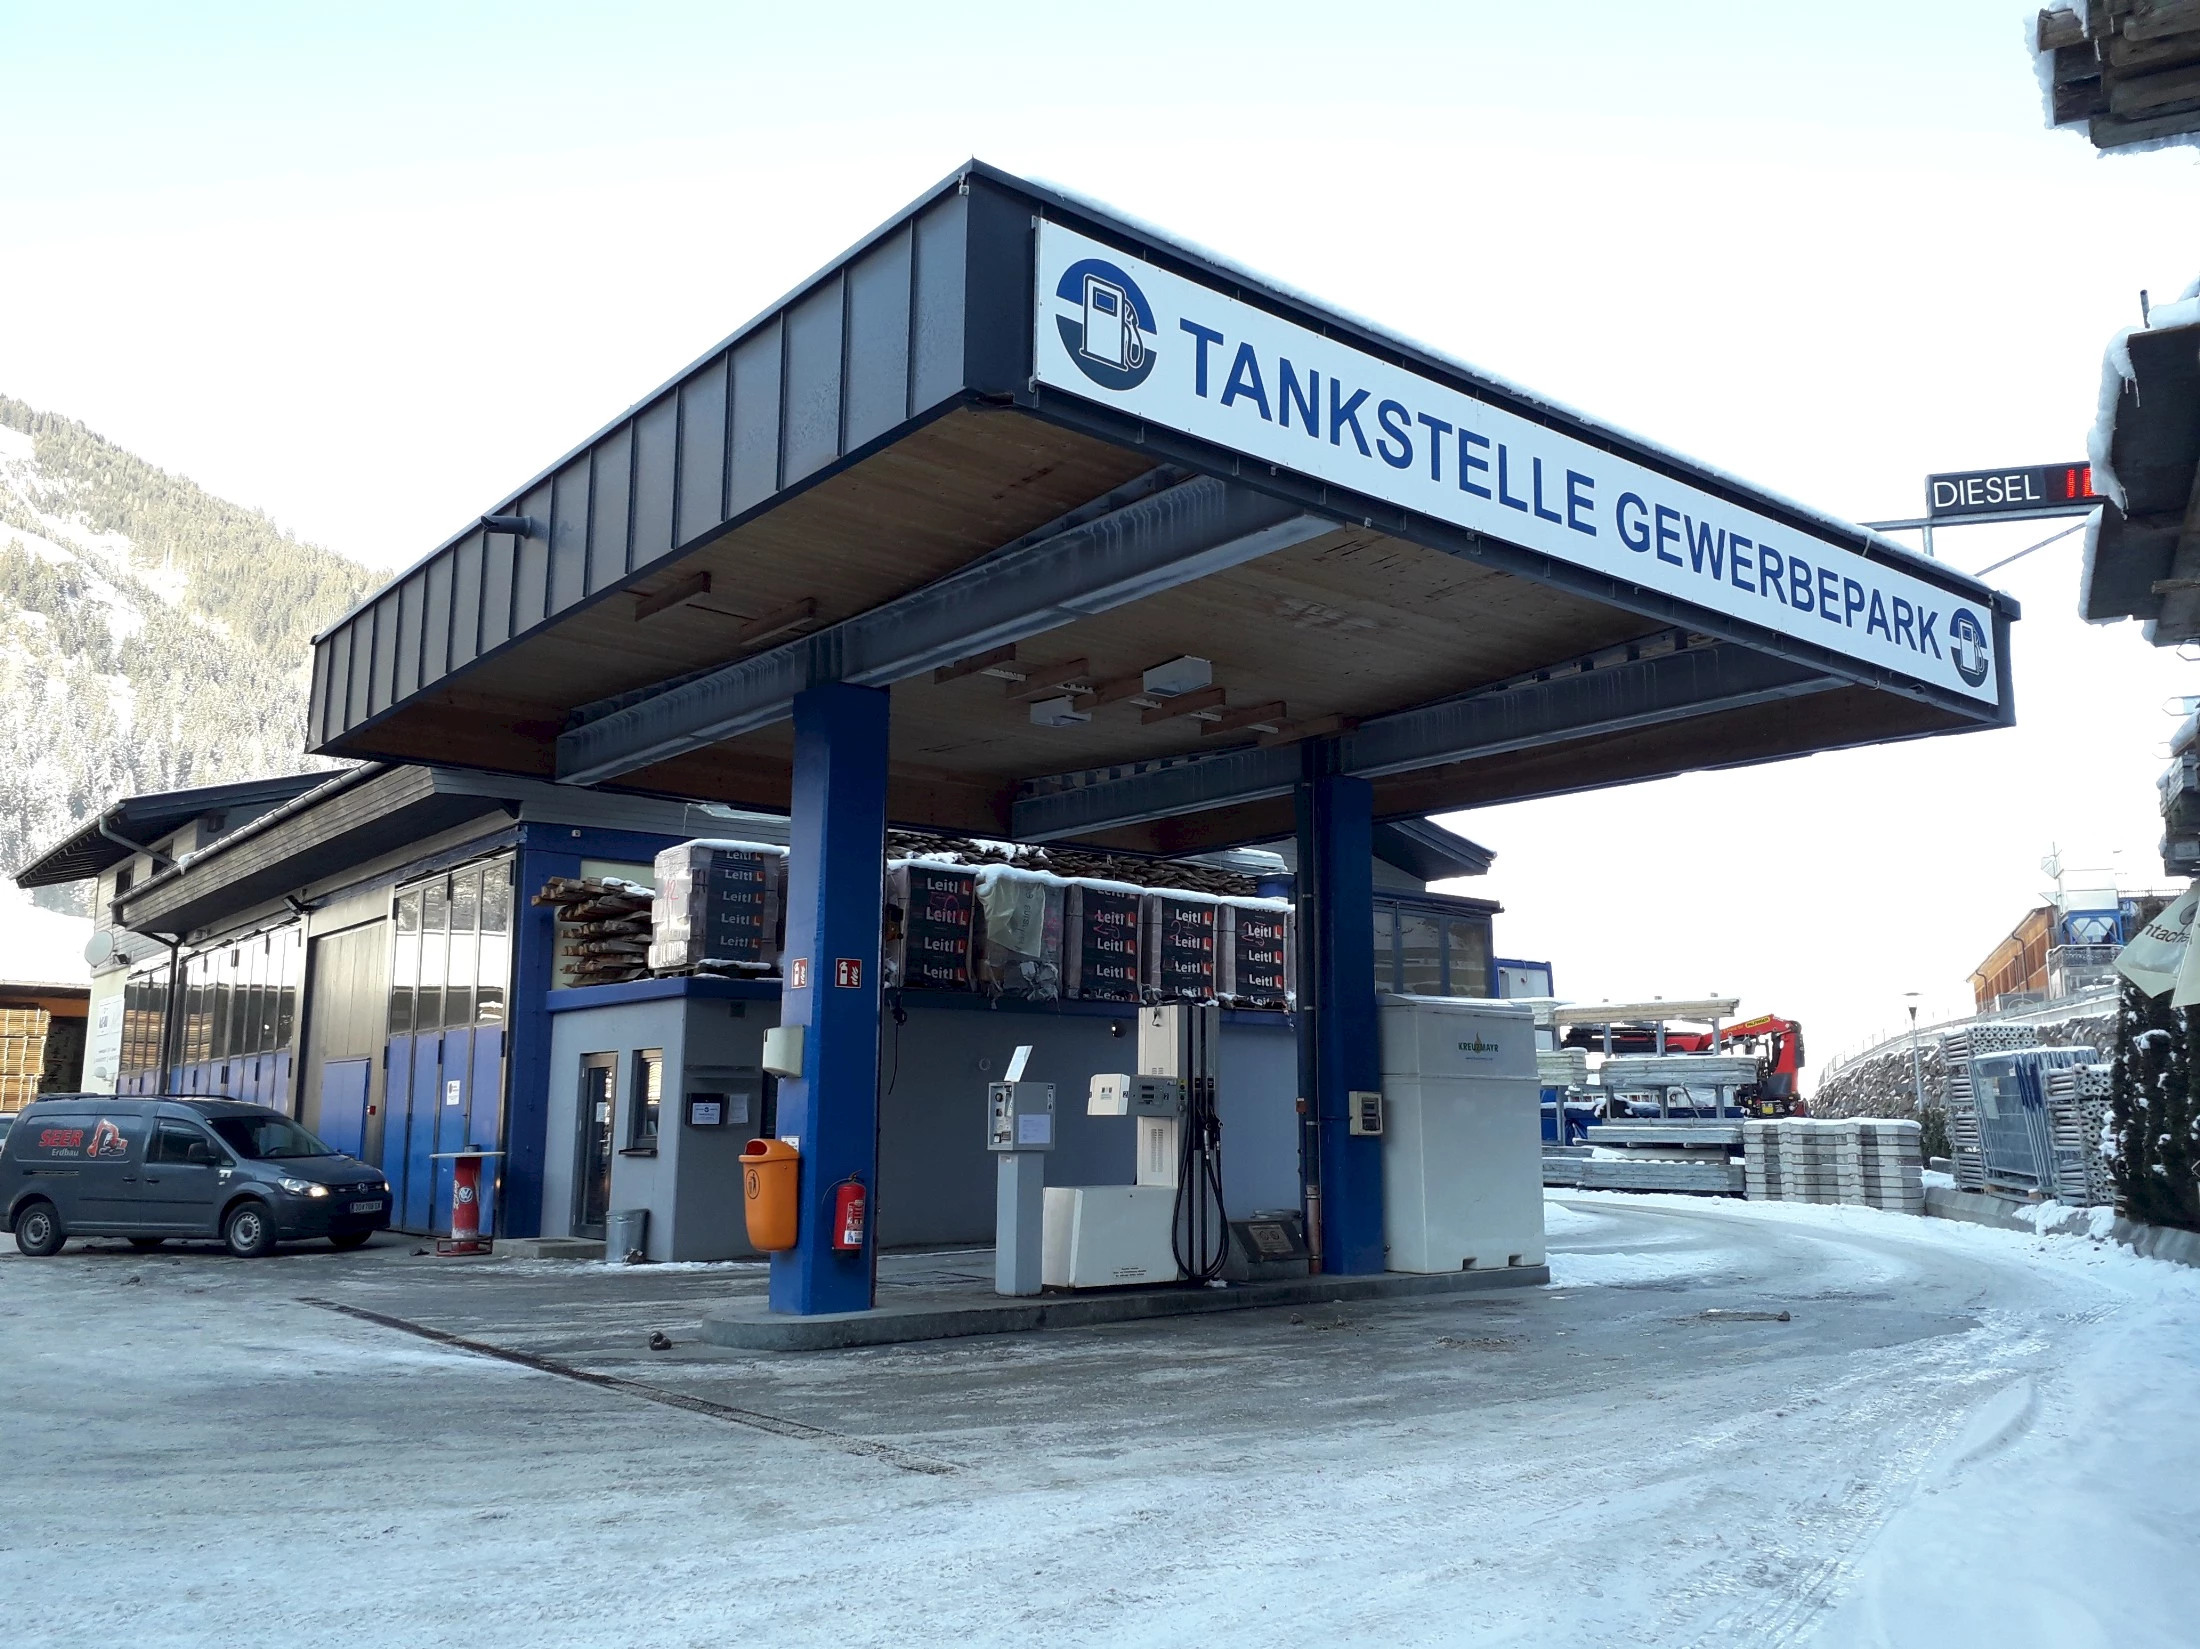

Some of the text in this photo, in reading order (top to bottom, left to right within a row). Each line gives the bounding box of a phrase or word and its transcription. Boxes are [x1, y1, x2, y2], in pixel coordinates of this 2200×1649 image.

[1179, 317, 1943, 660] TANKSTELLE GEWERBEPARK
[1933, 474, 2041, 508] DIESEL
[725, 869, 753, 881] Leitl
[927, 877, 970, 896] Leitl L
[723, 890, 751, 903] Leitl
[721, 913, 750, 925] Leitl
[926, 906, 967, 926] Leitl L
[1097, 909, 1124, 926] Leitl
[1175, 908, 1201, 924] Leitl
[1247, 924, 1272, 938] Leitl
[720, 935, 748, 948] Leitl
[924, 936, 965, 954] Leitl L
[1097, 938, 1124, 953] Leitl
[1175, 935, 1200, 949] Leitl
[1248, 949, 1272, 963] Leitl
[923, 963, 953, 980] Leitl
[1096, 964, 1124, 979] Leitl
[1175, 960, 1200, 974] Leitl
[1248, 974, 1273, 987] Leitl
[1458, 1042, 1499, 1052] KREUZMAYR
[39, 1128, 84, 1147] SEER
[51, 1148, 79, 1157] Erdbau
